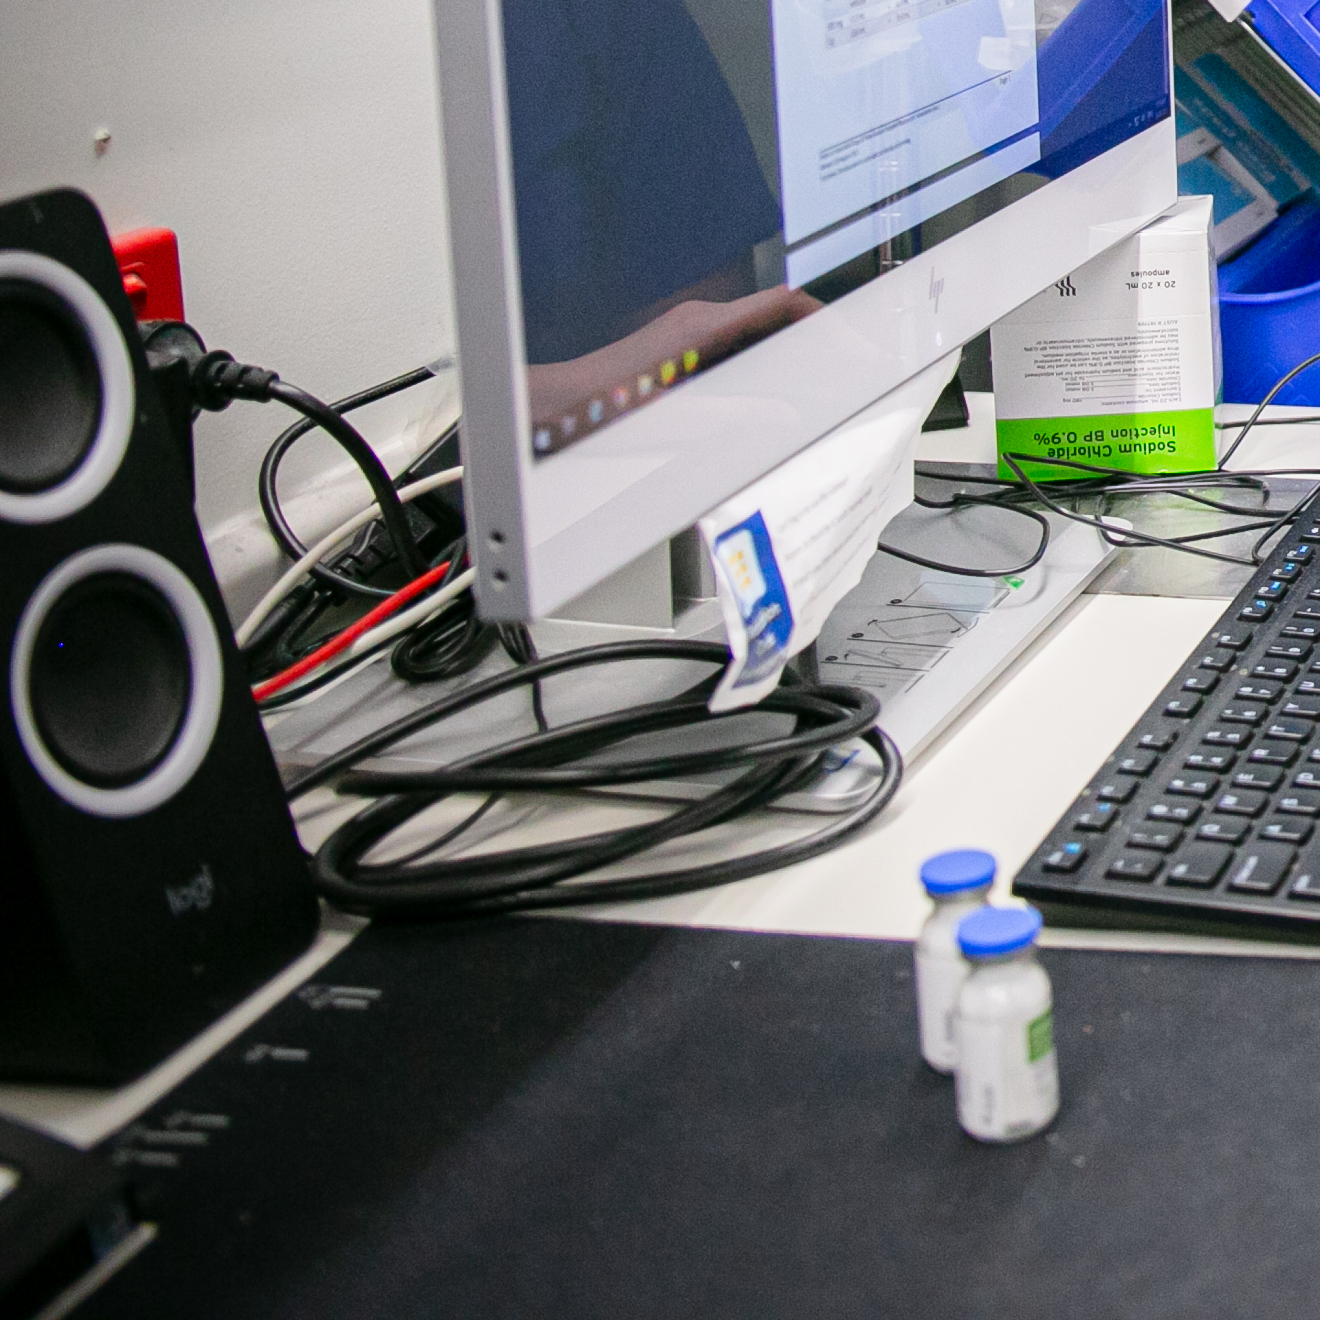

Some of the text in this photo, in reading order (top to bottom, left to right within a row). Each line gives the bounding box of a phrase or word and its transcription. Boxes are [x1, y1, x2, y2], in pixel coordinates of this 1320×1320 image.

[1130, 270, 1170, 278] ampoules
[1125, 282, 1139, 290] mL
[1141, 281, 1153, 289] 20
[1033, 424, 1176, 445] Injection BP 0.9%
[1047, 441, 1176, 458] Sodium Chloride
